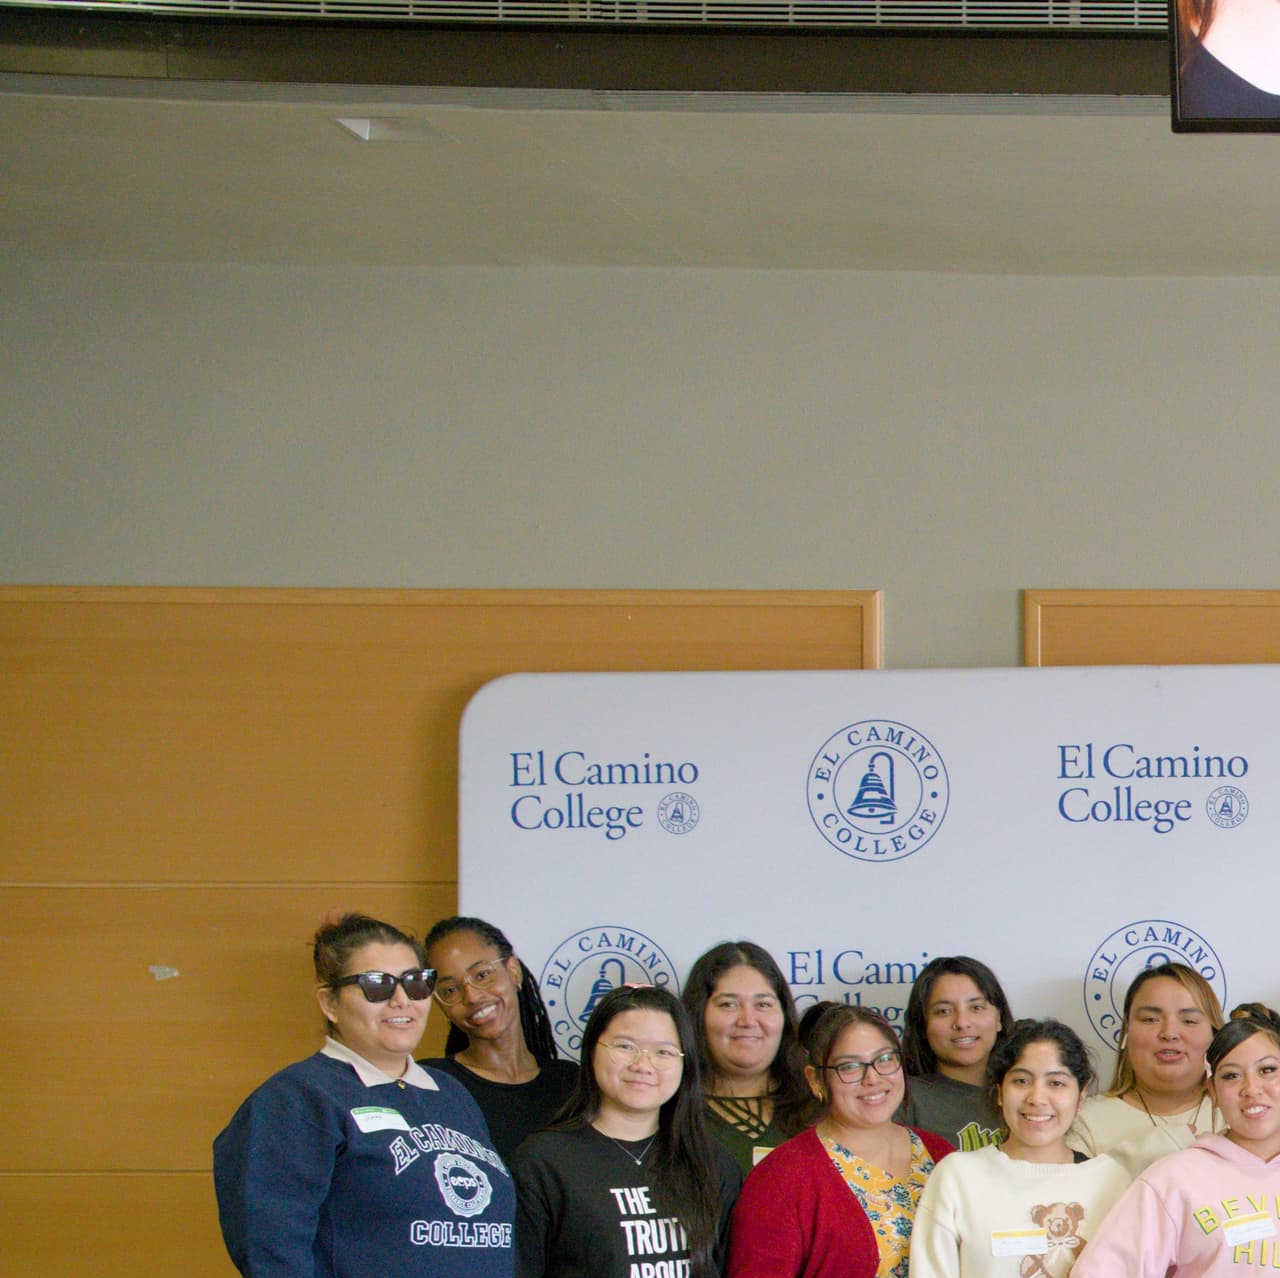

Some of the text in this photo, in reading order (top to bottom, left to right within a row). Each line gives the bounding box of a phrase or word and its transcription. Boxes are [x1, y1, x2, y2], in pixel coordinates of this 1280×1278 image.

[509, 750, 699, 786] El Camino
[815, 726, 938, 782] EL CAMINO
[1056, 743, 1249, 780] El Camino
[511, 793, 644, 841] College
[1058, 785, 1192, 834] College
[823, 809, 936, 855] COLLEGE
[546, 932, 669, 989] EL CAMINO
[787, 949, 824, 984] El
[1092, 926, 1216, 982] EL CAMINO
[389, 1135, 420, 1176] EL
[609, 1186, 657, 1215] THE
[410, 1219, 512, 1248] COLLEGE
